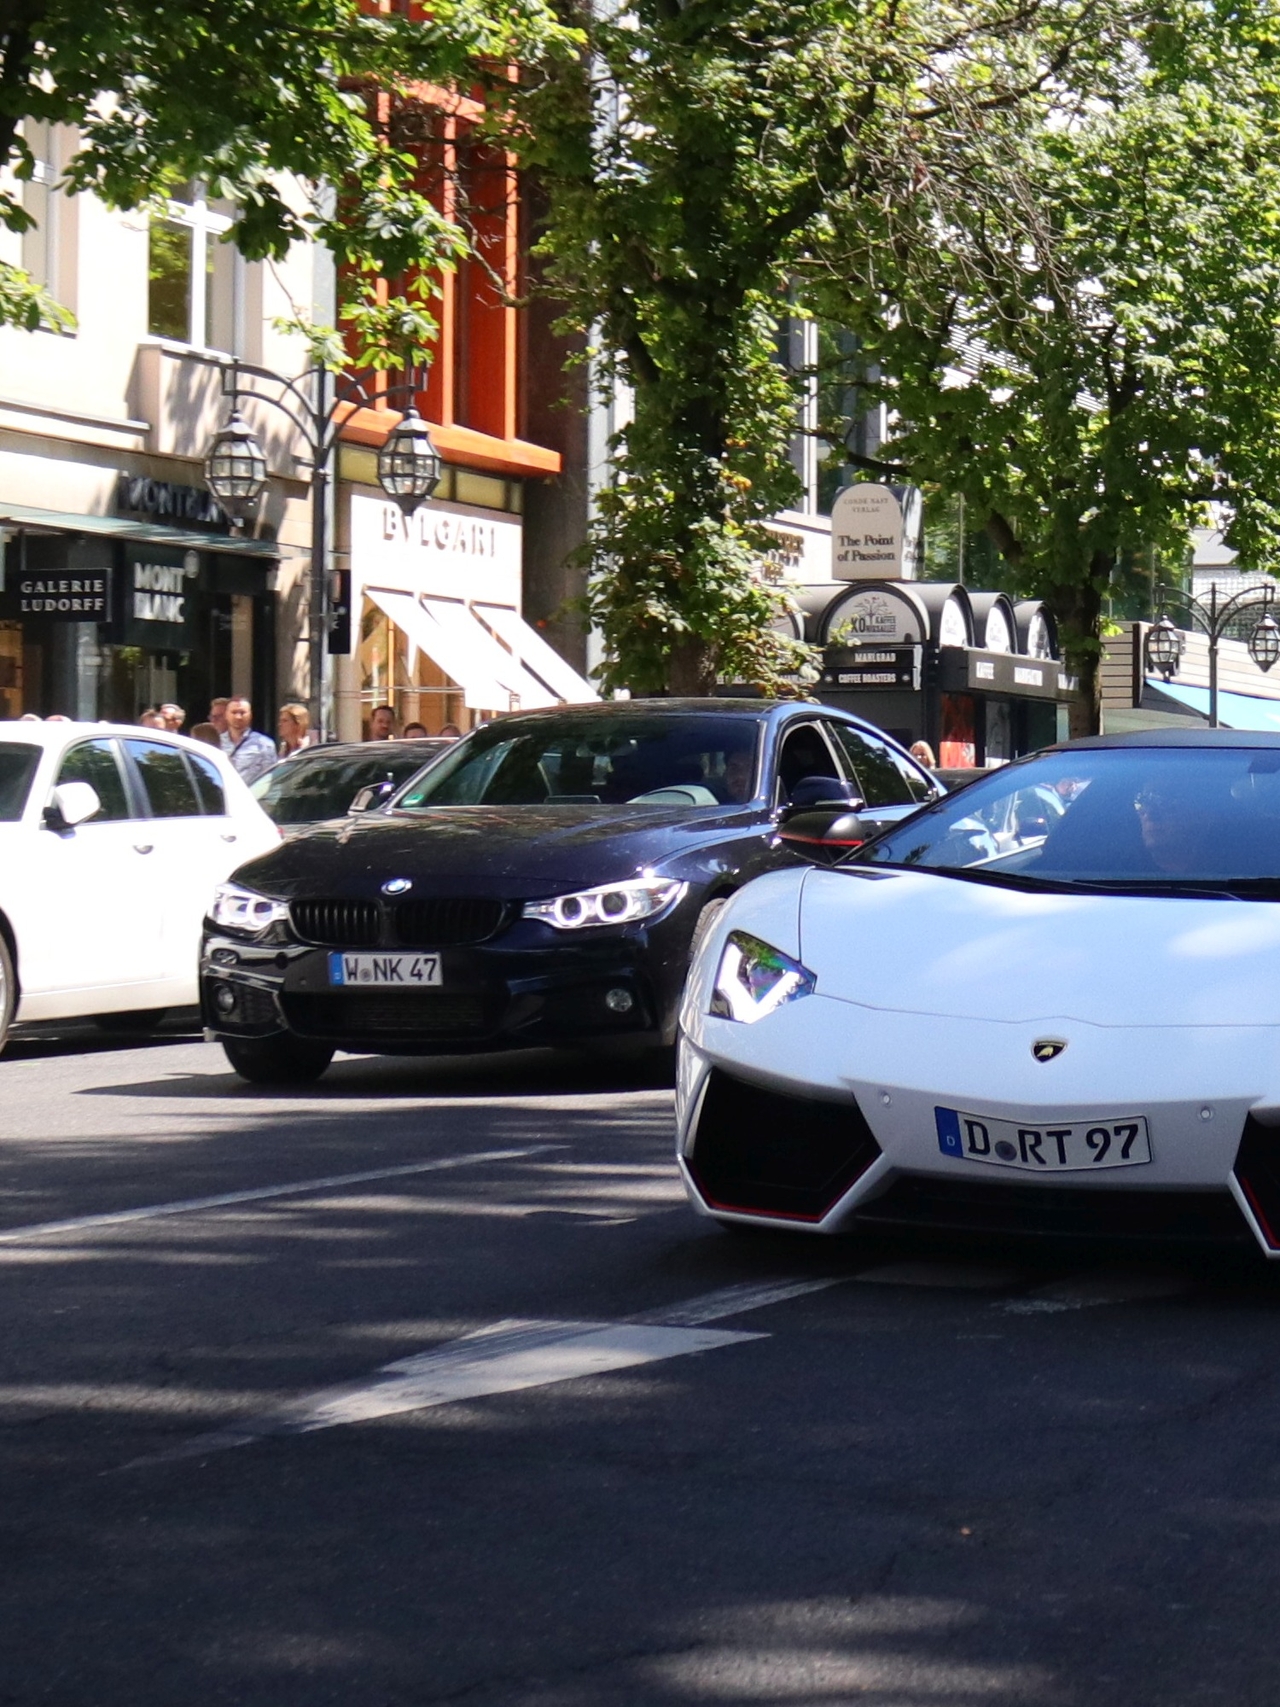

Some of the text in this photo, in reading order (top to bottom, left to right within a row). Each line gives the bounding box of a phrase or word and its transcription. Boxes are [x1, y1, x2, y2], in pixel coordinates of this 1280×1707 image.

[382, 507, 495, 557] BVLGARI
[838, 535, 861, 547] The
[864, 534, 894, 547] Point
[837, 550, 850, 562] of
[852, 550, 896, 562] Passion
[20, 580, 104, 593] GALERIE
[133, 562, 185, 593] MONT
[20, 598, 104, 612] LUDORFF
[133, 592, 185, 623] BLANC
[838, 673, 897, 684] COFFEE ROASTERS
[344, 957, 438, 982] W NK 47
[963, 1118, 1139, 1165] D RT 97
